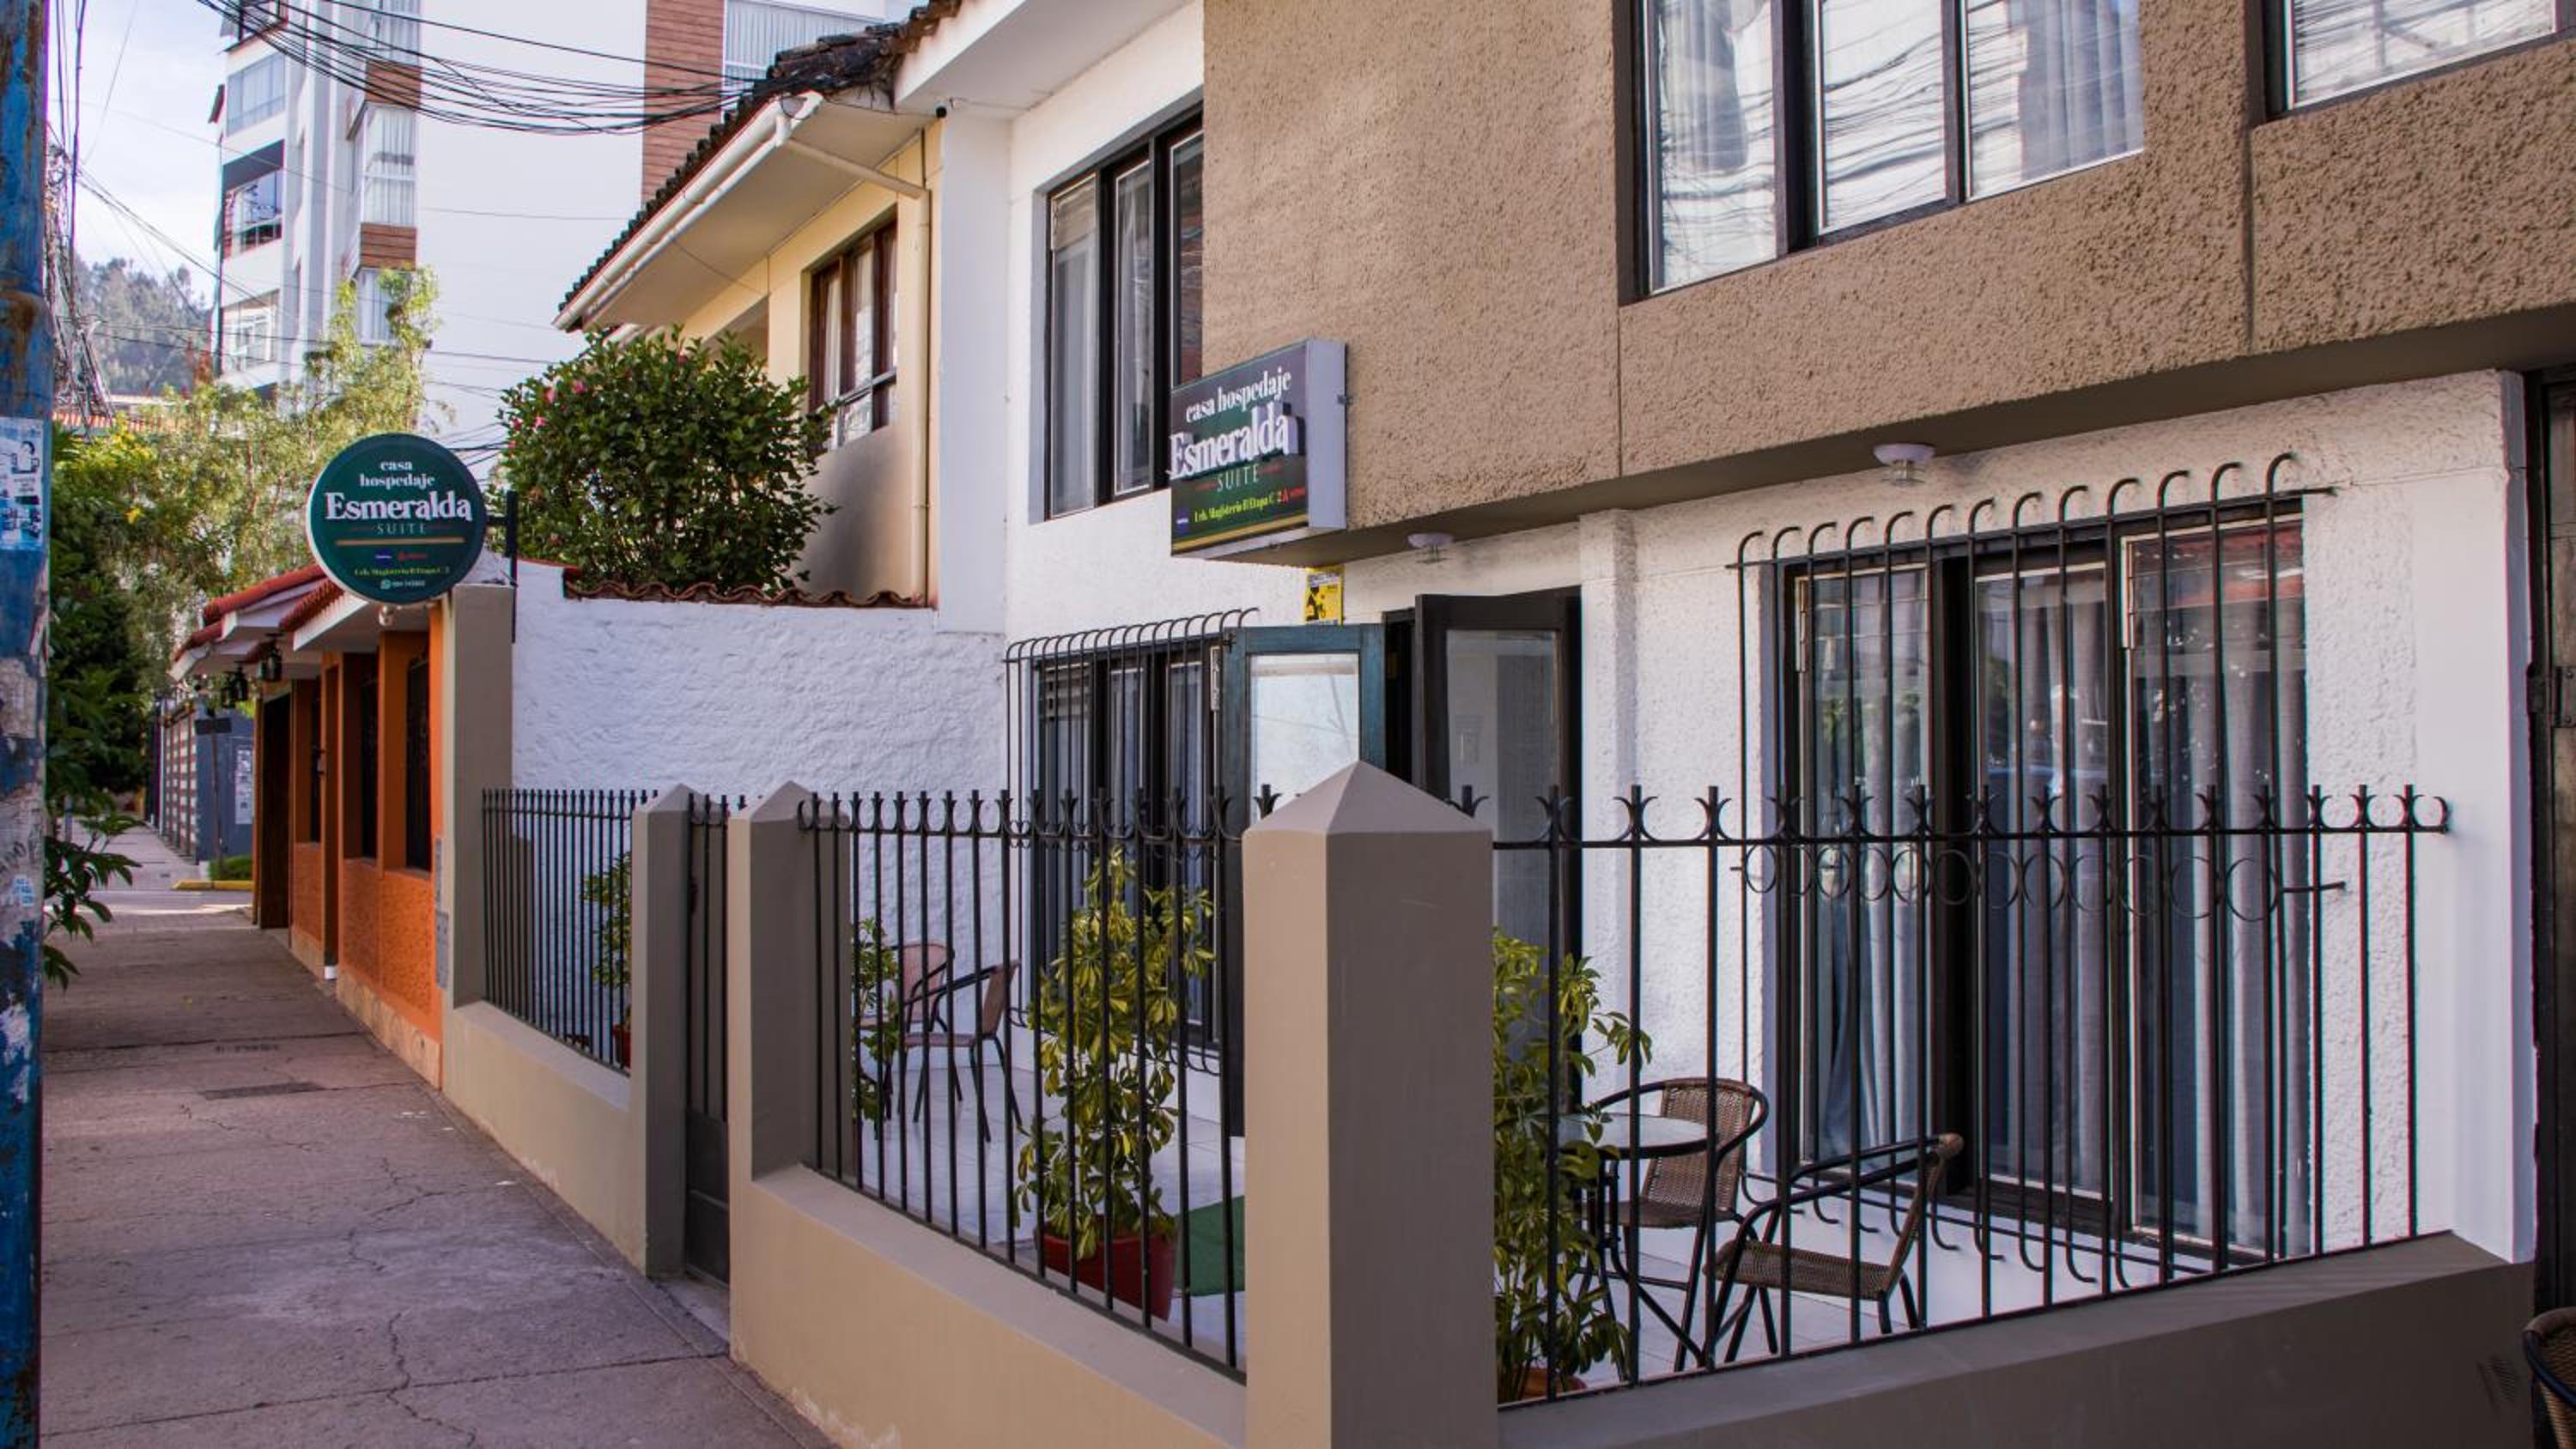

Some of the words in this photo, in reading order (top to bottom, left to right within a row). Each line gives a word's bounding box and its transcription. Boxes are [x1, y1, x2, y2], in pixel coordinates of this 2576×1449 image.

[1186, 397, 1215, 423] casa
[1218, 367, 1291, 413] hospedaje
[1167, 401, 1291, 481] Esmeralda
[380, 460, 413, 471] casa
[1217, 464, 1260, 492] SUITE
[359, 473, 436, 490] hospedaje
[325, 490, 473, 523] Esmeralda
[376, 523, 428, 535] SUITE
